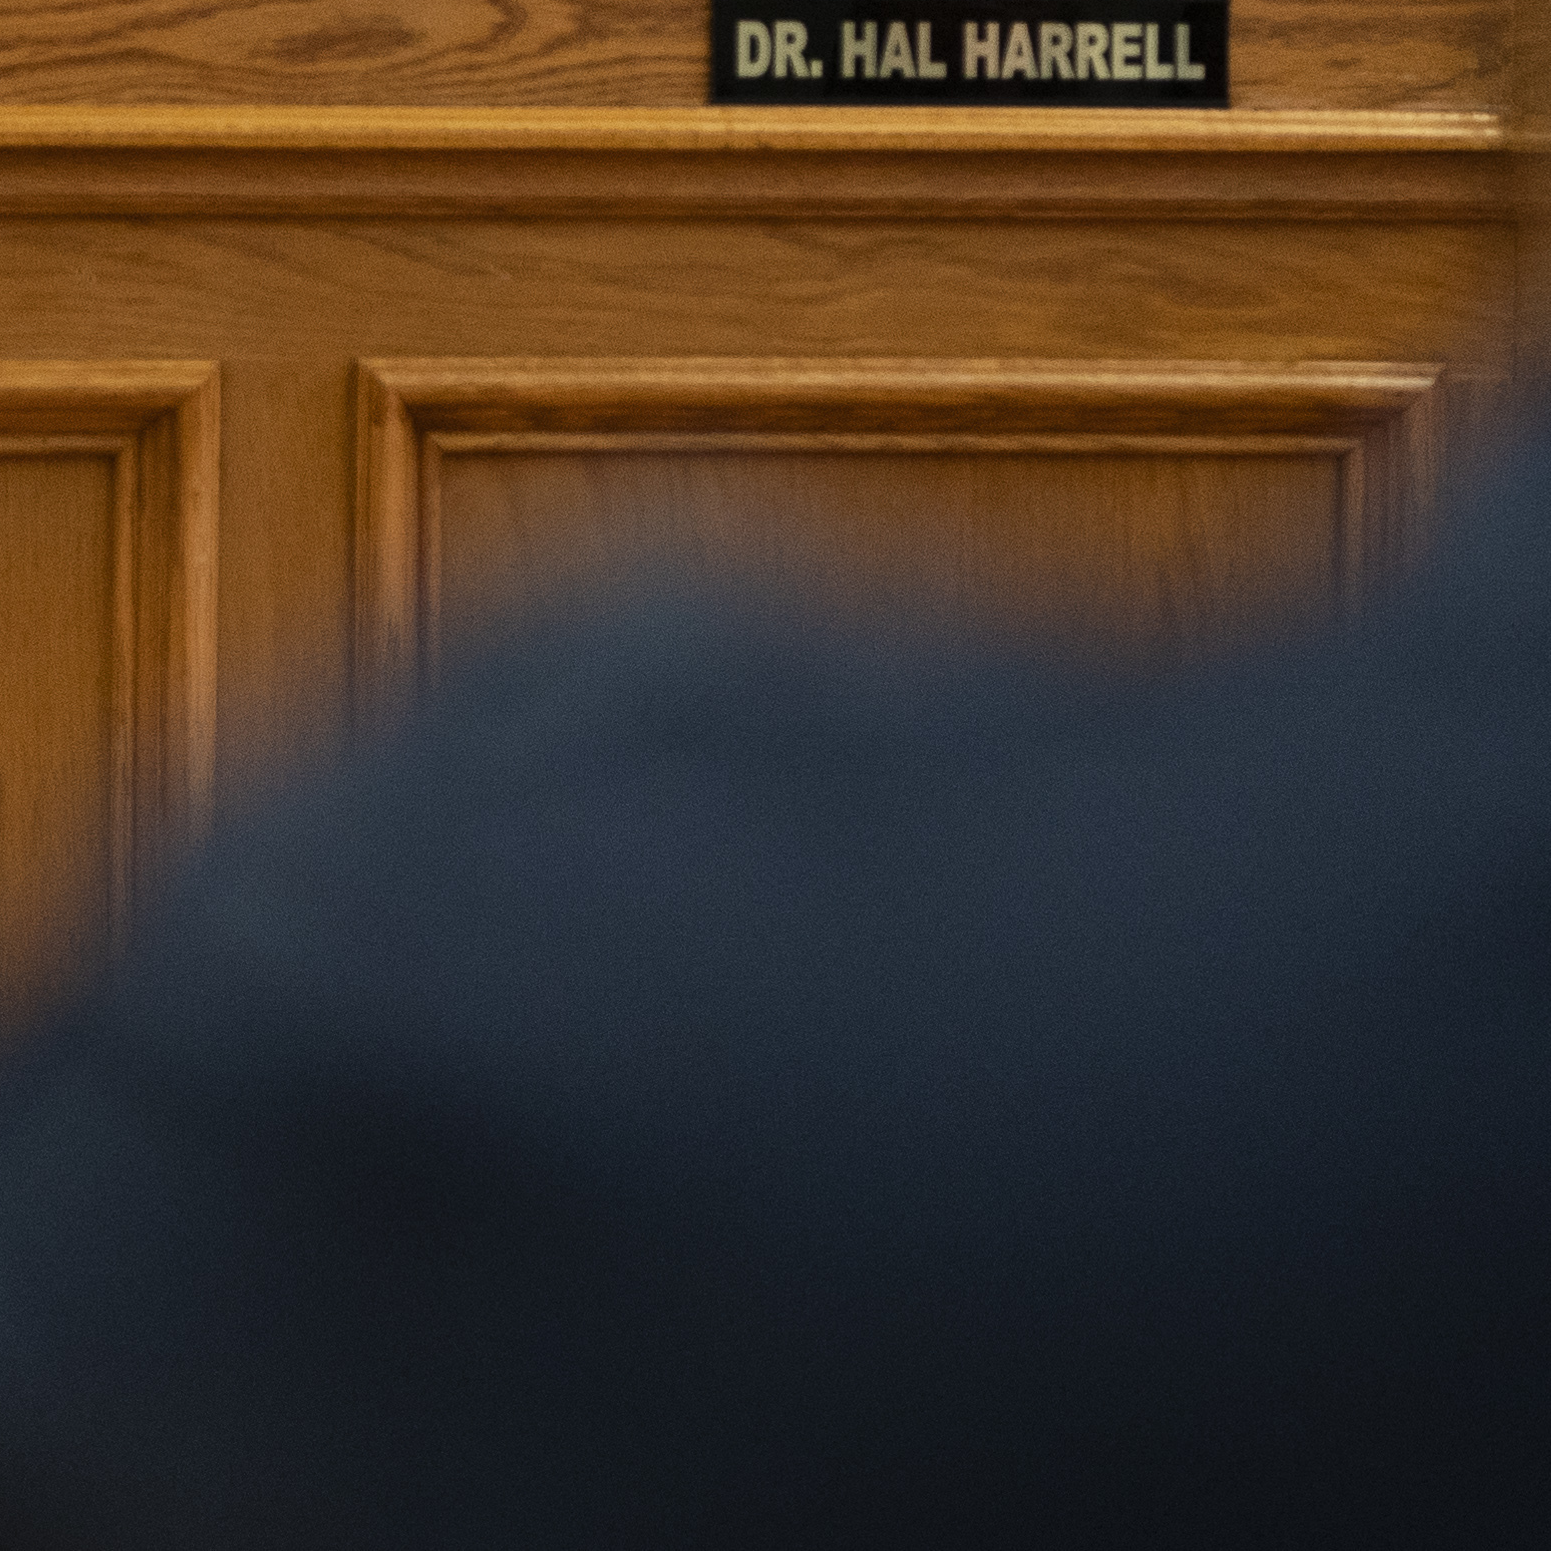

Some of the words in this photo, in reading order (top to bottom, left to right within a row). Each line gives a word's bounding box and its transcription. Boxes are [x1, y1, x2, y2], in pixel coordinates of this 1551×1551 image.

[735, 20, 824, 79] DR.
[841, 21, 948, 80] HAL
[963, 21, 1207, 81] HARRELL
